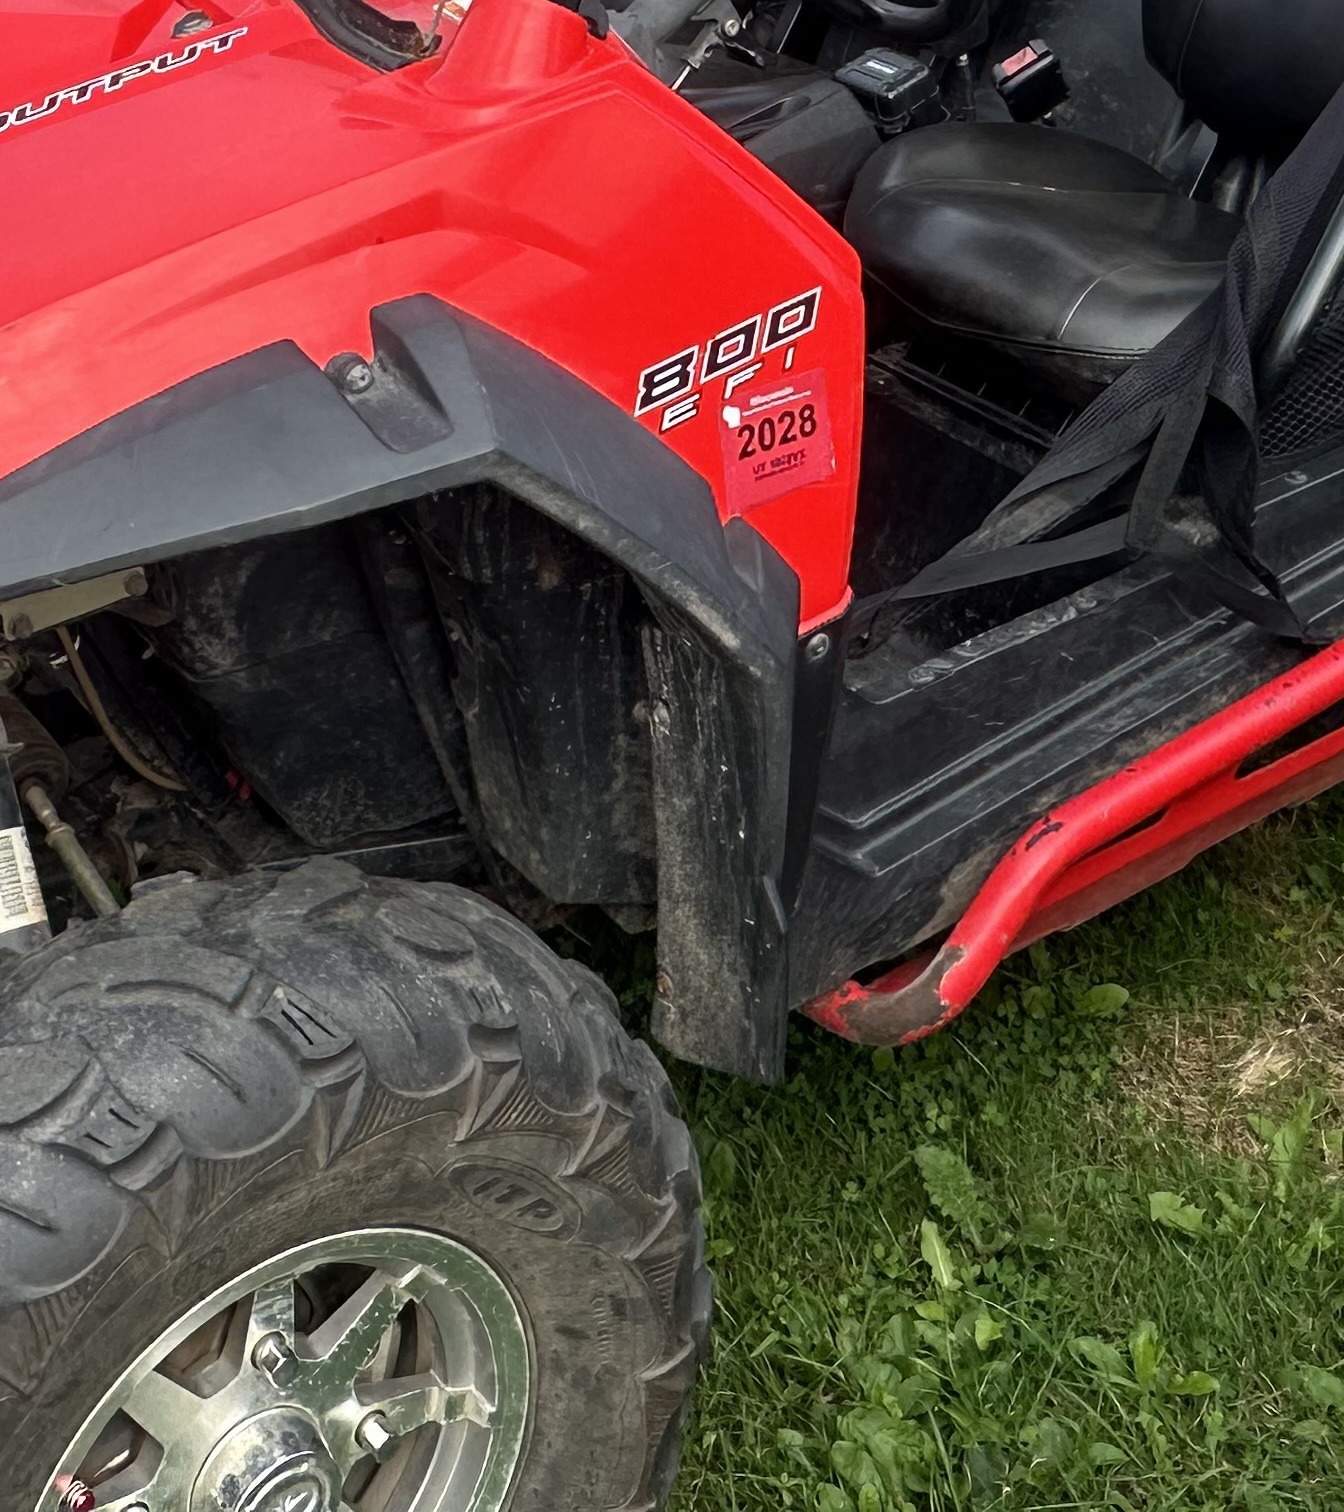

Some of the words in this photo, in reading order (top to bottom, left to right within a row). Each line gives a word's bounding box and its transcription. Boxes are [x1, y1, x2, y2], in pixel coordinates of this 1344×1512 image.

[634, 286, 822, 418] 800
[737, 403, 817, 461] 2028
[472, 1175, 557, 1220] ITP
